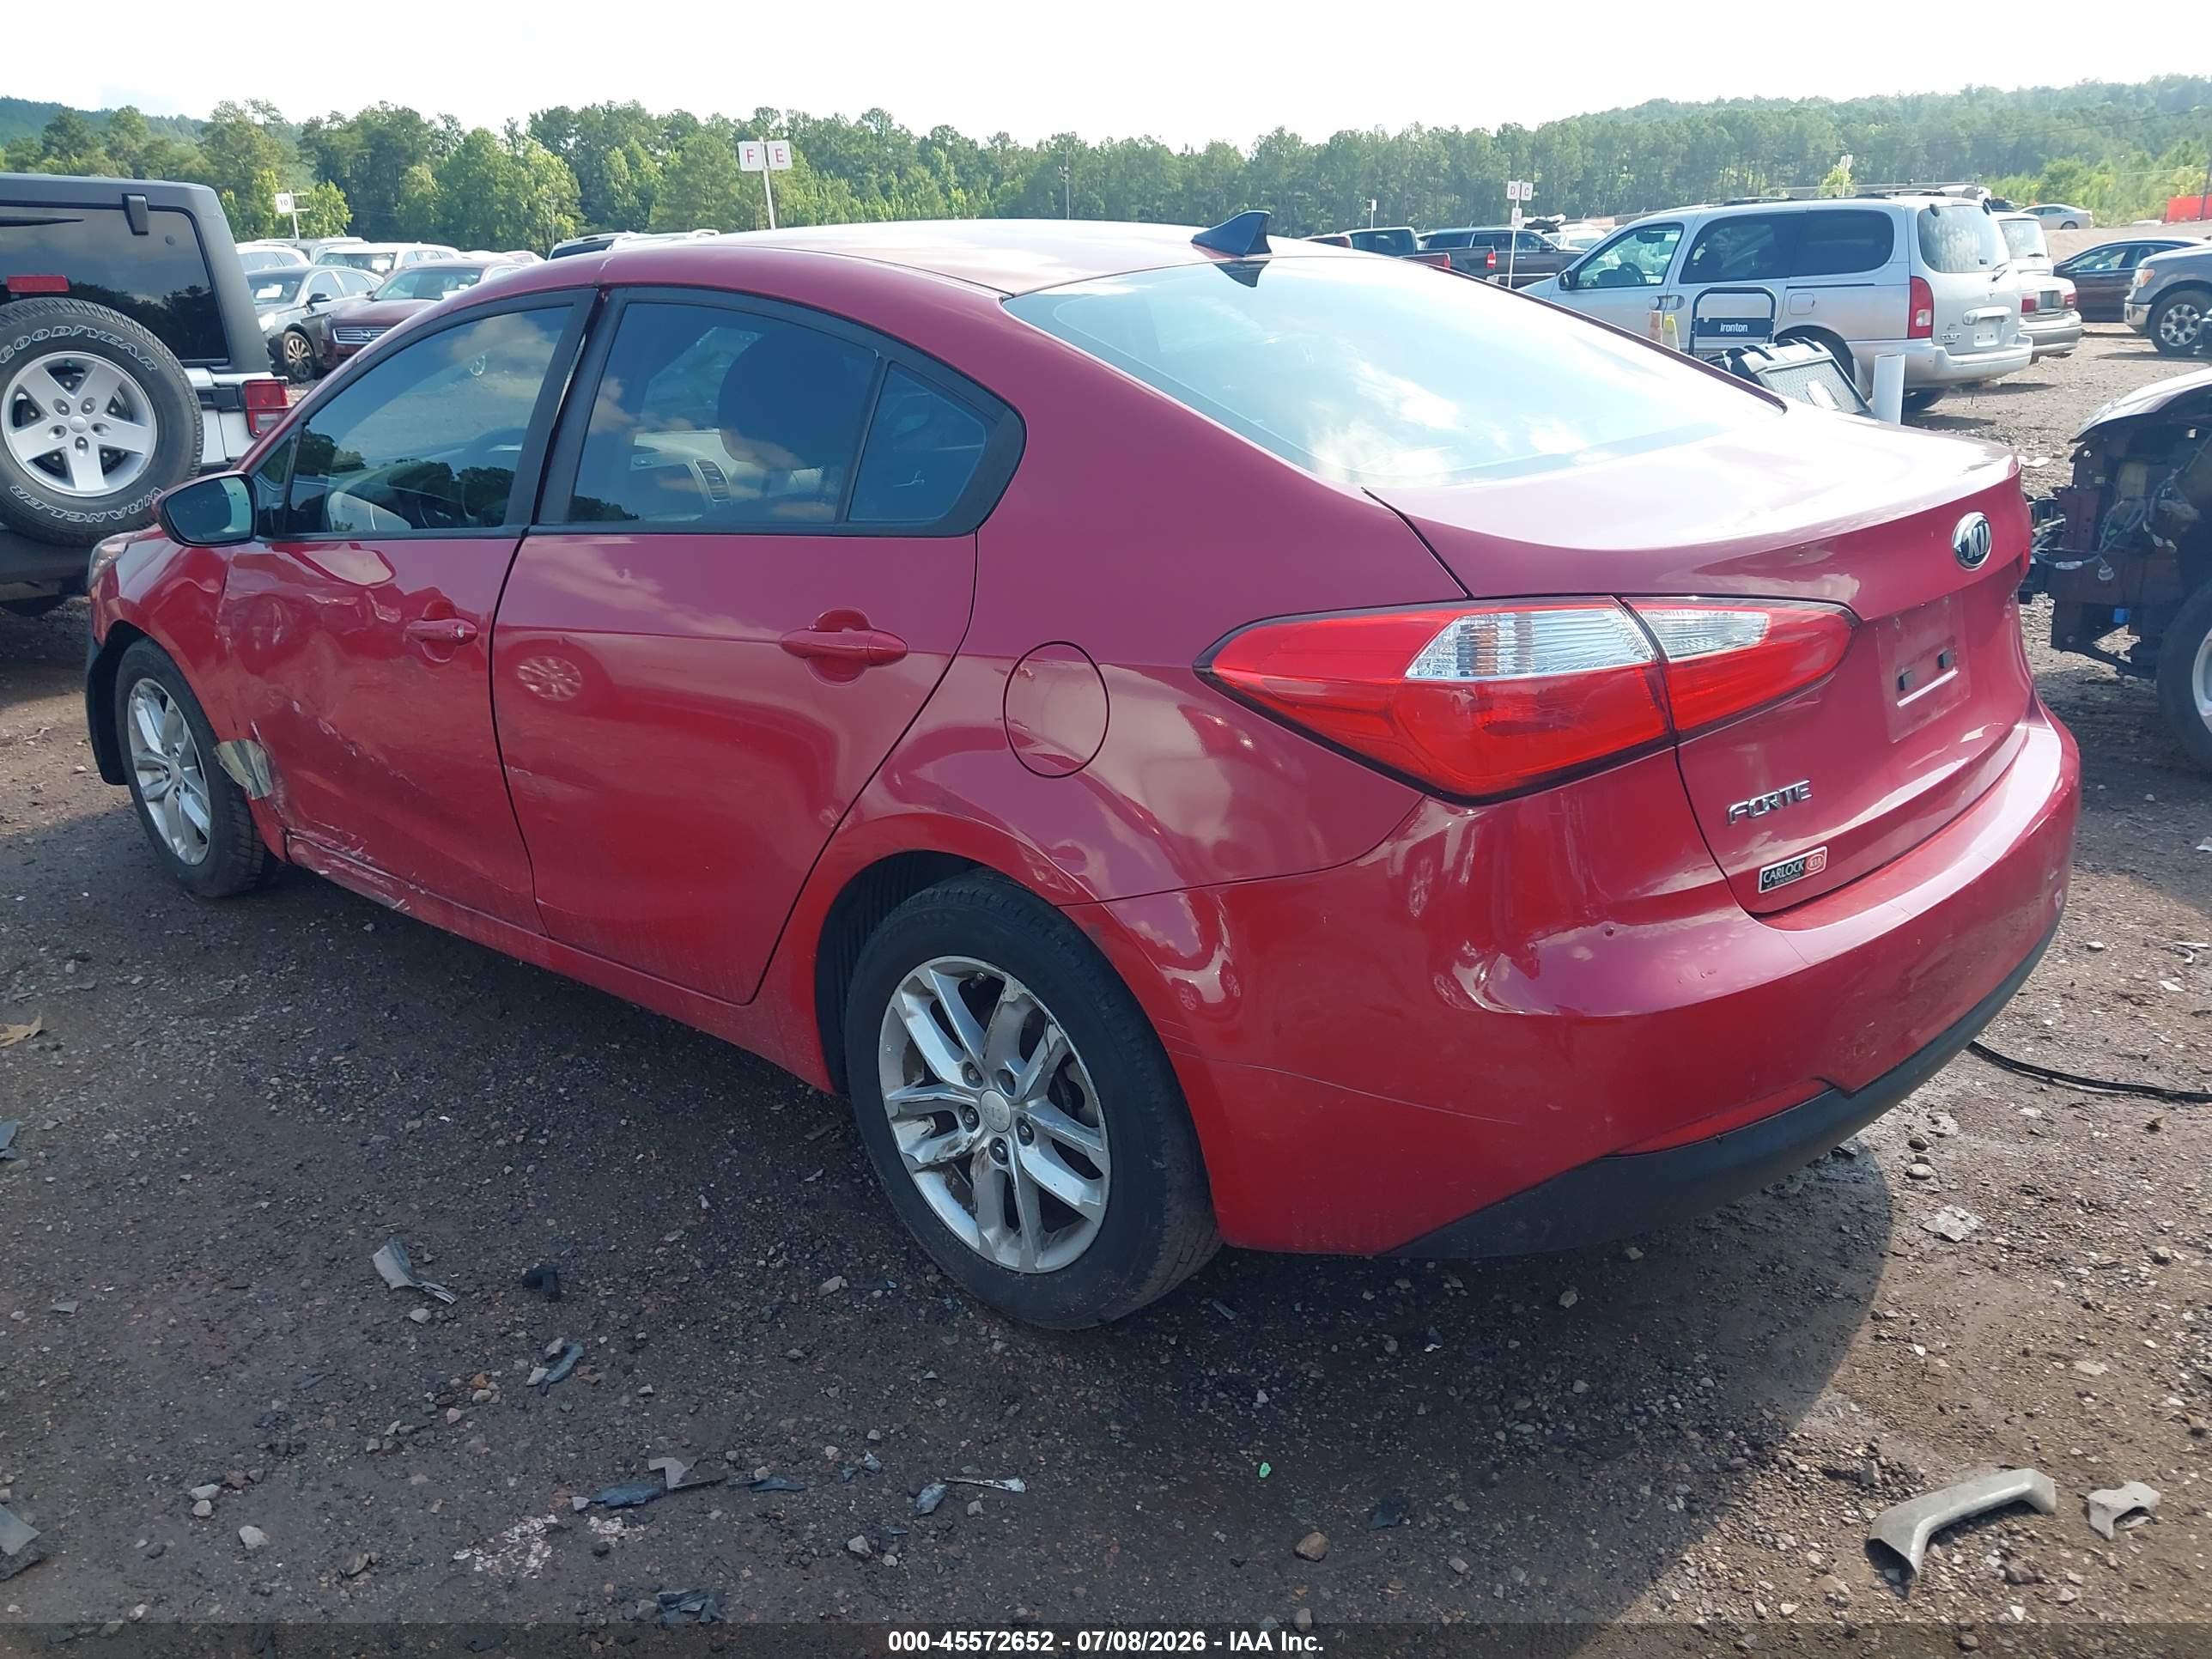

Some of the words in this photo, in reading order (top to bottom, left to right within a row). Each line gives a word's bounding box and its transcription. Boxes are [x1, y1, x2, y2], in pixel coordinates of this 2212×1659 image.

[745, 148, 755, 164] F
[774, 148, 785, 163] E
[0, 325, 158, 372] GOODYEAR
[1727, 779, 1813, 825] FORTE
[1762, 859, 1805, 884] CARLOCK
